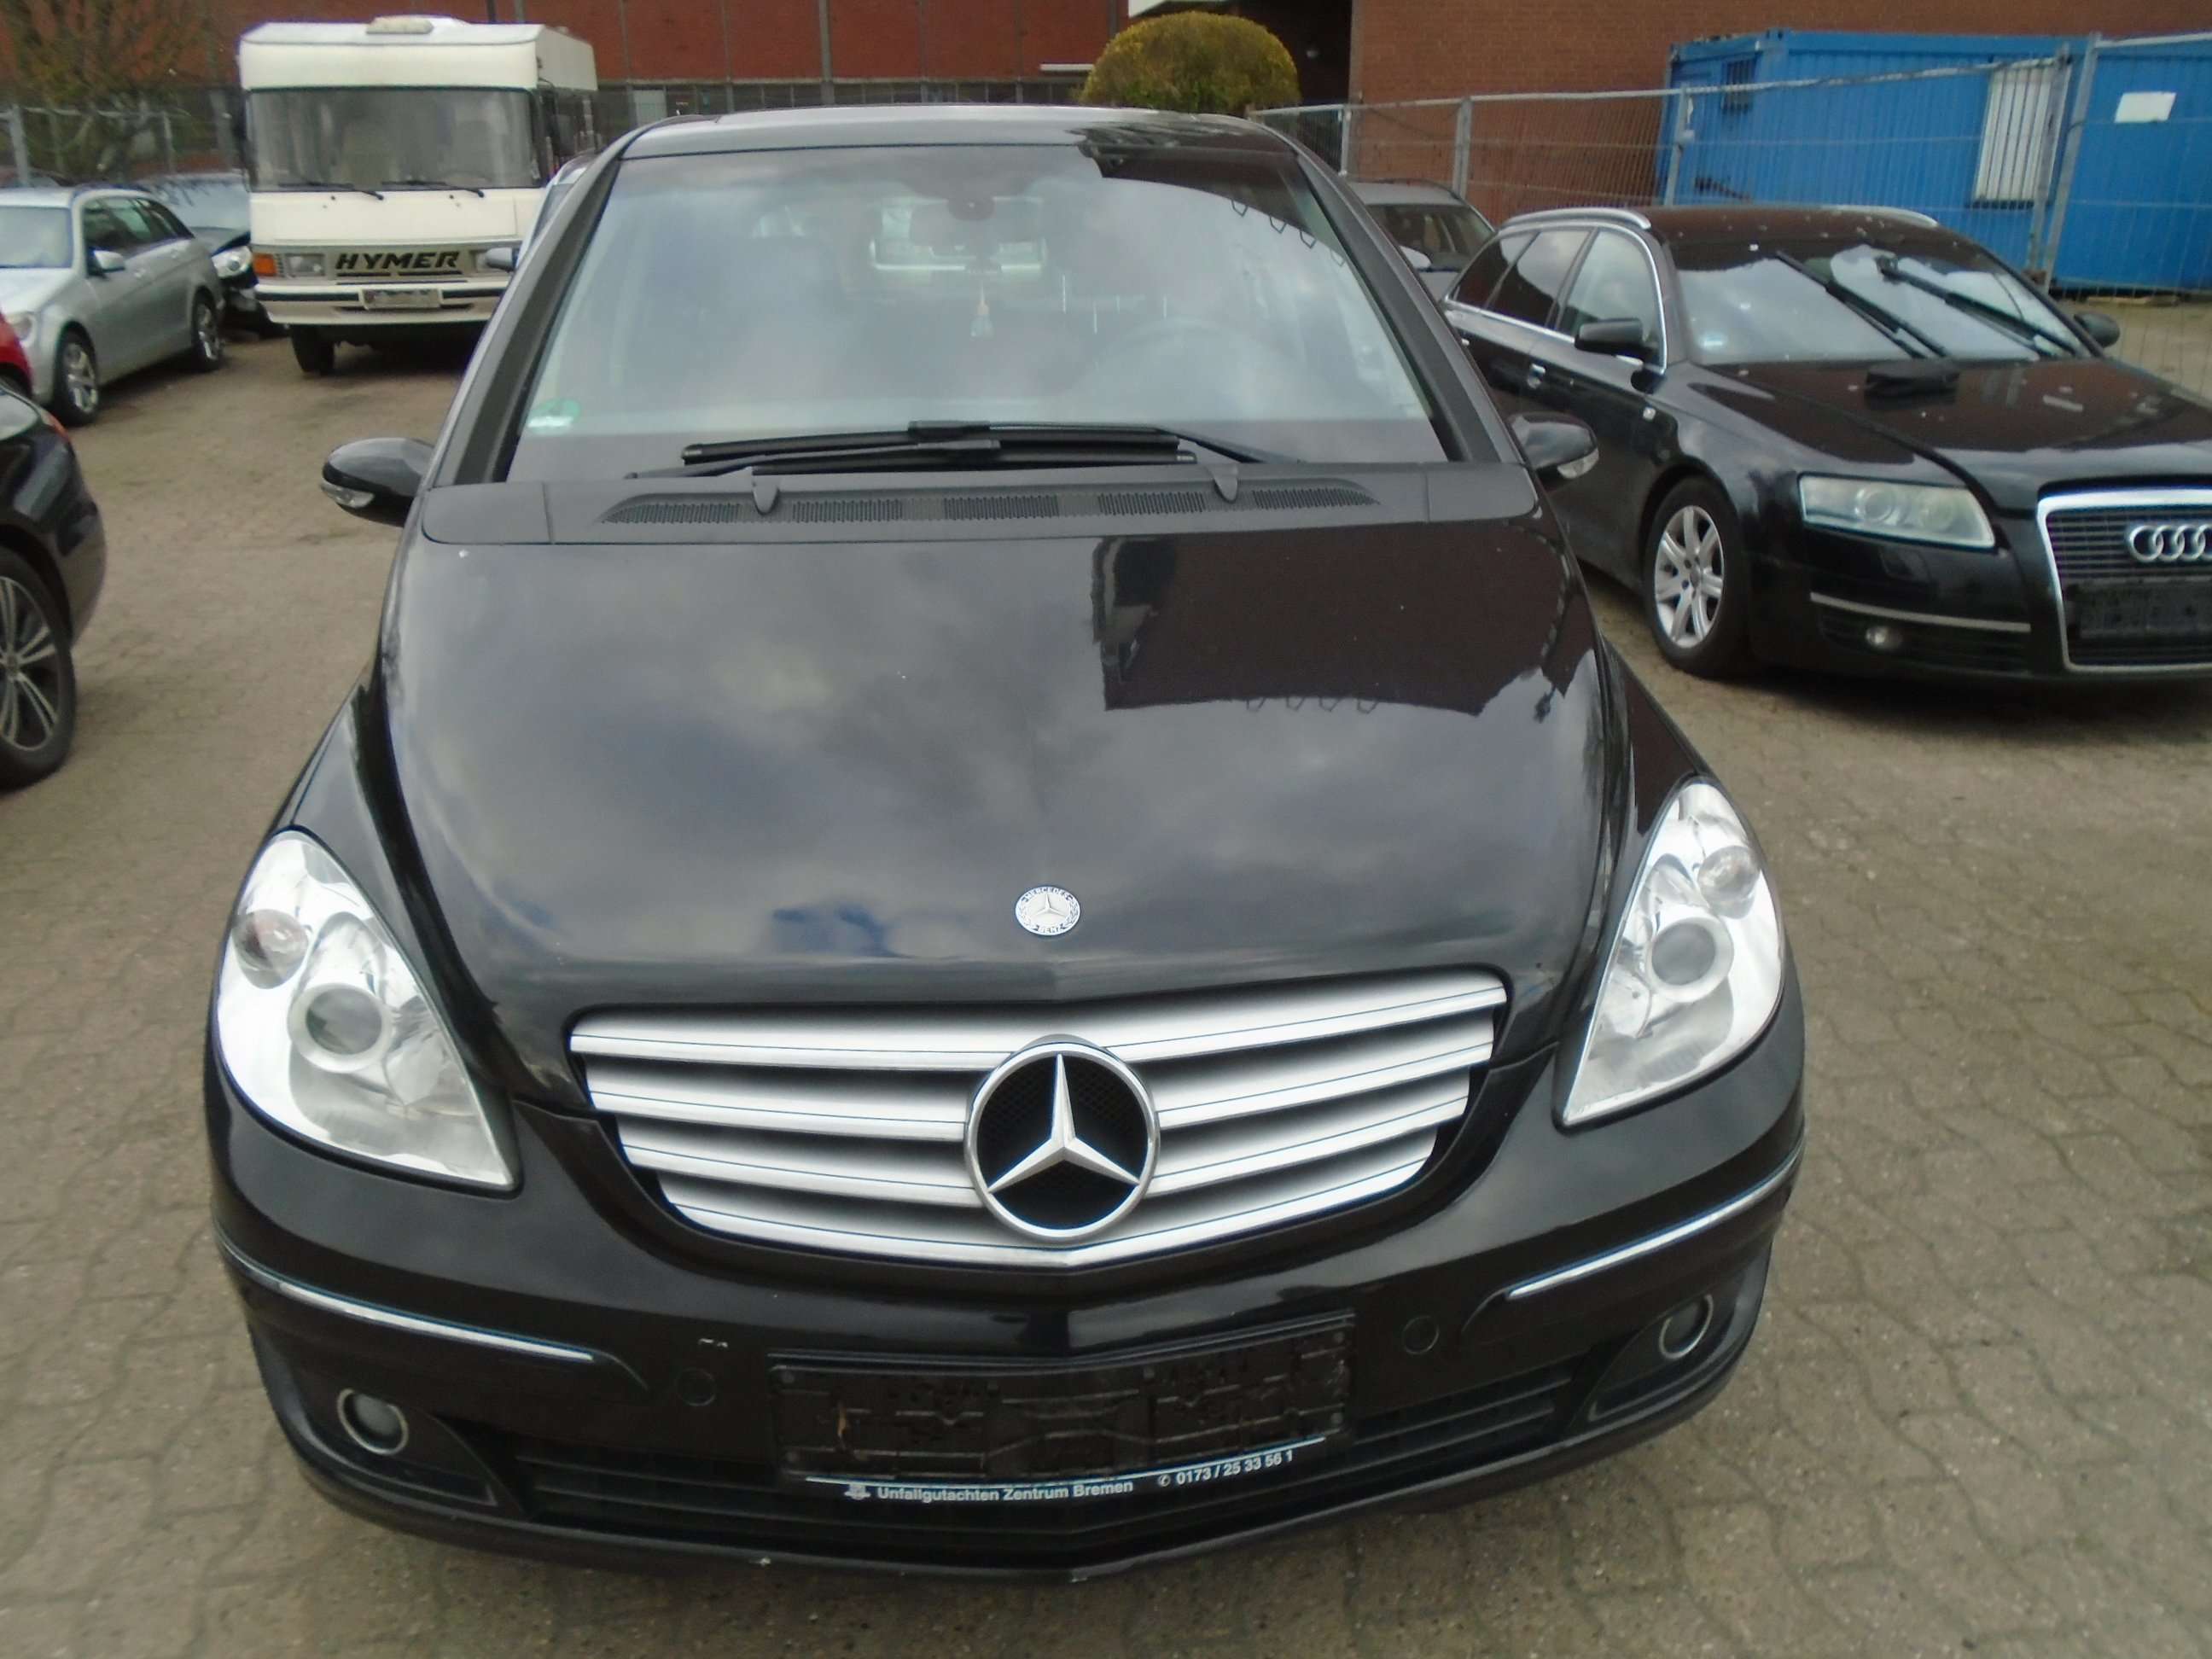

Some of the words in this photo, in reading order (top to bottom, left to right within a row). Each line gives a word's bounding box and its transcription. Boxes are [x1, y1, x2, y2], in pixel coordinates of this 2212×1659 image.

[335, 251, 461, 270] HYMER
[1176, 1468, 1211, 1485] 0173
[1223, 1463, 1241, 1476] 25
[1244, 1458, 1262, 1471] 33
[1285, 1450, 1293, 1461] 1
[877, 1487, 999, 1503] Unfallgutachten
[1003, 1487, 1069, 1501] Zentrum
[1073, 1481, 1133, 1498] Bremen
